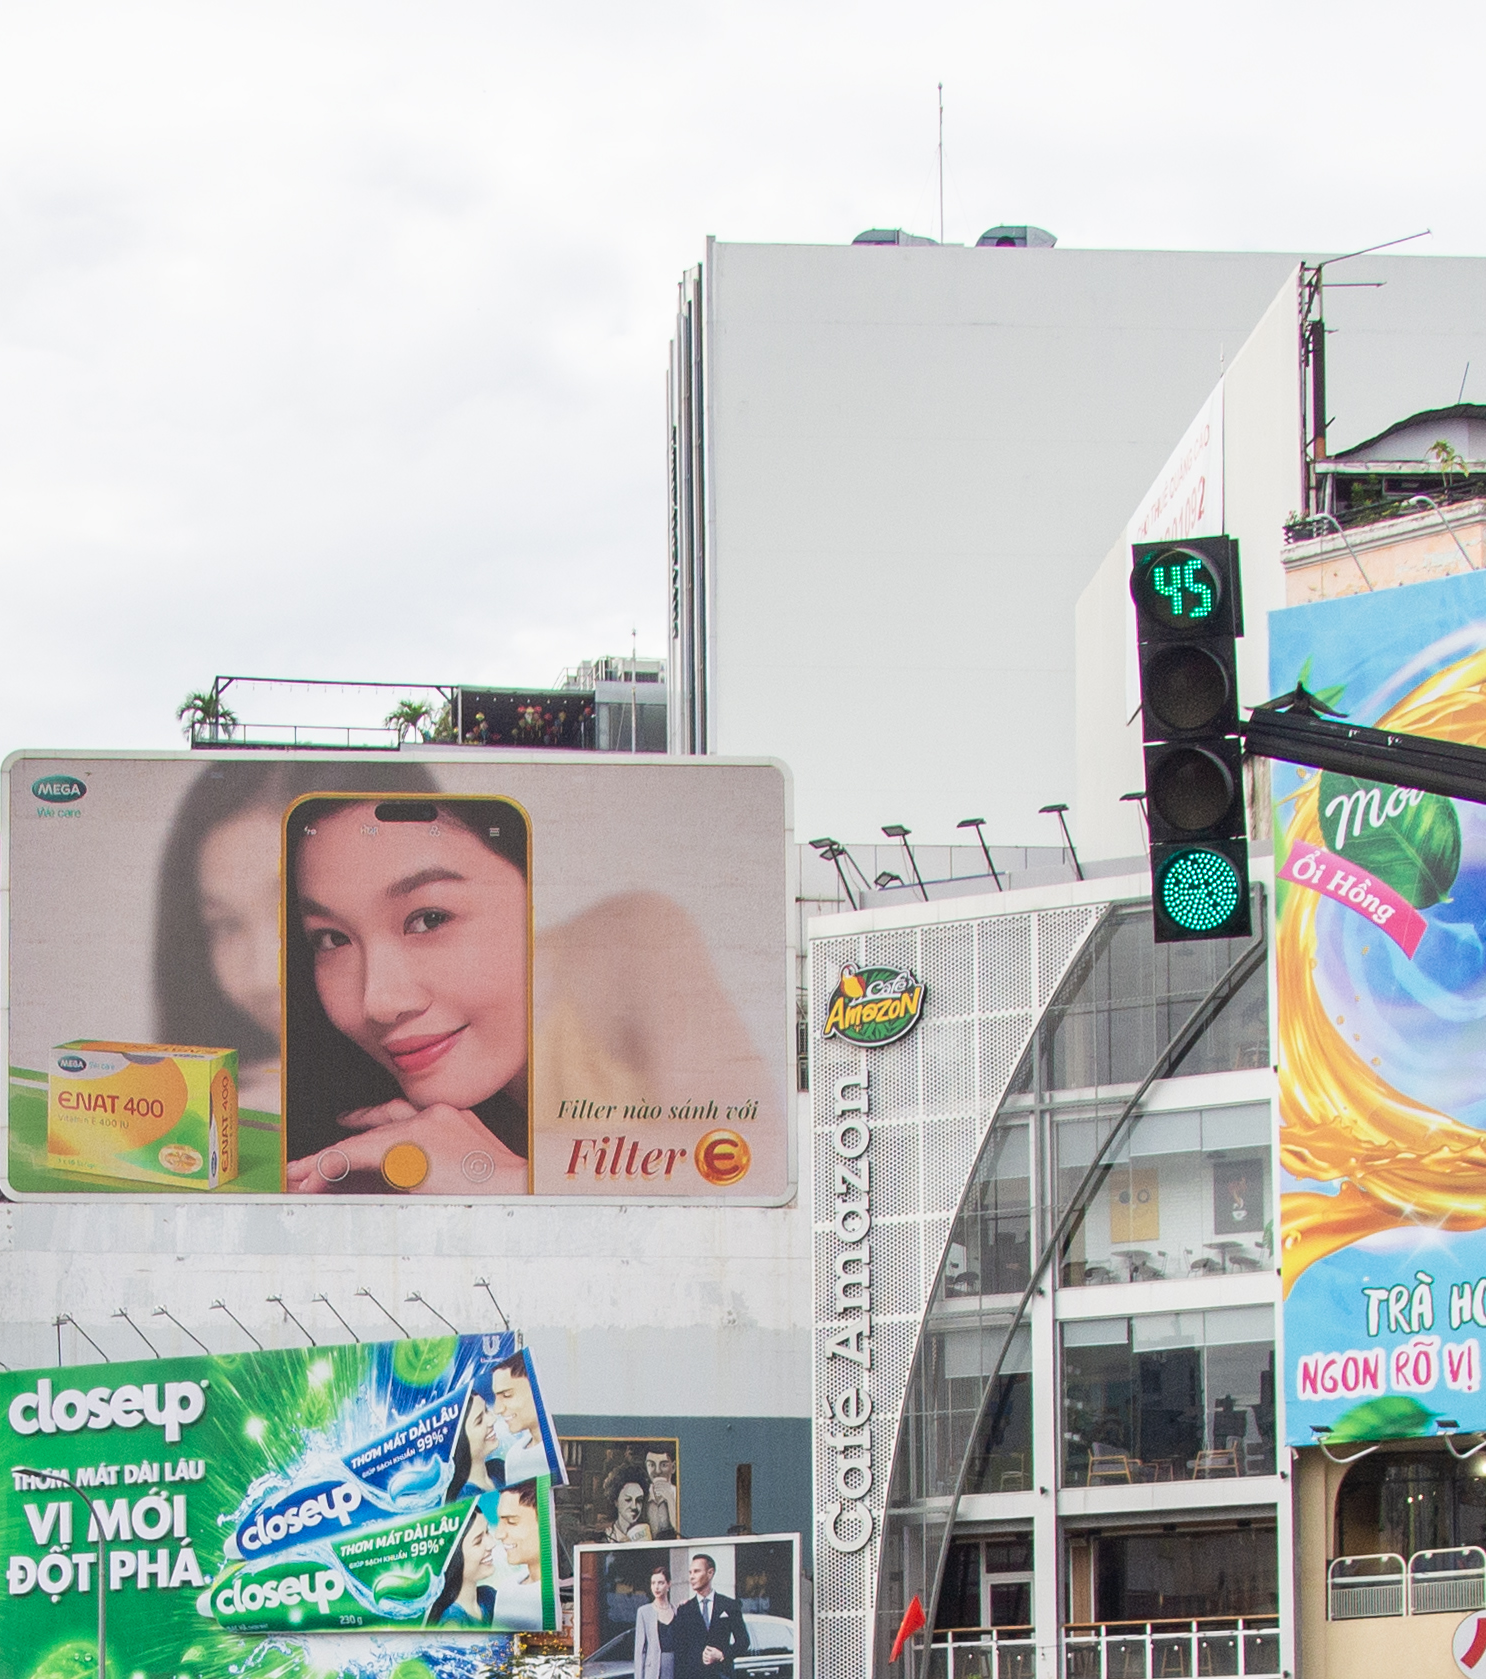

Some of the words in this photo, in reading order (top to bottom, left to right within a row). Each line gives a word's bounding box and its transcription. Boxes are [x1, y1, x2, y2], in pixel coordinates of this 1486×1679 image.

[1154, 559, 1212, 618] 45
[36, 807, 55, 818] We
[57, 808, 81, 818] care
[37, 784, 81, 796] MEGA
[1292, 850, 1326, 884] Ổi
[1326, 869, 1395, 924] Hồng
[58, 1091, 119, 1114] ENAT
[123, 1097, 164, 1118] 400
[99, 1118, 117, 1128] 400
[557, 1099, 618, 1120] Filter
[623, 1098, 663, 1120] nào
[668, 1098, 719, 1120] sánh
[726, 1098, 760, 1120] với
[565, 1136, 688, 1177] Filter
[825, 1070, 871, 1371] Amazon
[1363, 1270, 1435, 1337] TRÀ
[1299, 1350, 1382, 1396] NGON
[1394, 1336, 1433, 1386] RÕ
[1446, 1348, 1476, 1392] VỊ
[7, 1378, 206, 1443] closeup
[350, 1447, 382, 1470] THƠM
[382, 1433, 407, 1454] MÁT
[408, 1418, 432, 1444] DÀI
[432, 1403, 459, 1430] LÂU
[76, 1460, 119, 1488] MÁT
[123, 1458, 160, 1485] DÀI
[164, 1457, 206, 1482] LÂU
[825, 1387, 874, 1553] Café
[88, 1488, 188, 1544] MỚI
[241, 1481, 363, 1551] closeup
[340, 1540, 375, 1558] THƠM
[376, 1529, 403, 1549] MÁT
[404, 1520, 430, 1543] DÀI
[430, 1515, 460, 1538] LÂU
[7, 1543, 96, 1604] ĐỘT
[110, 1535, 206, 1591] PHÁ
[216, 1568, 345, 1615] closeup
[339, 1614, 356, 1626] 230
